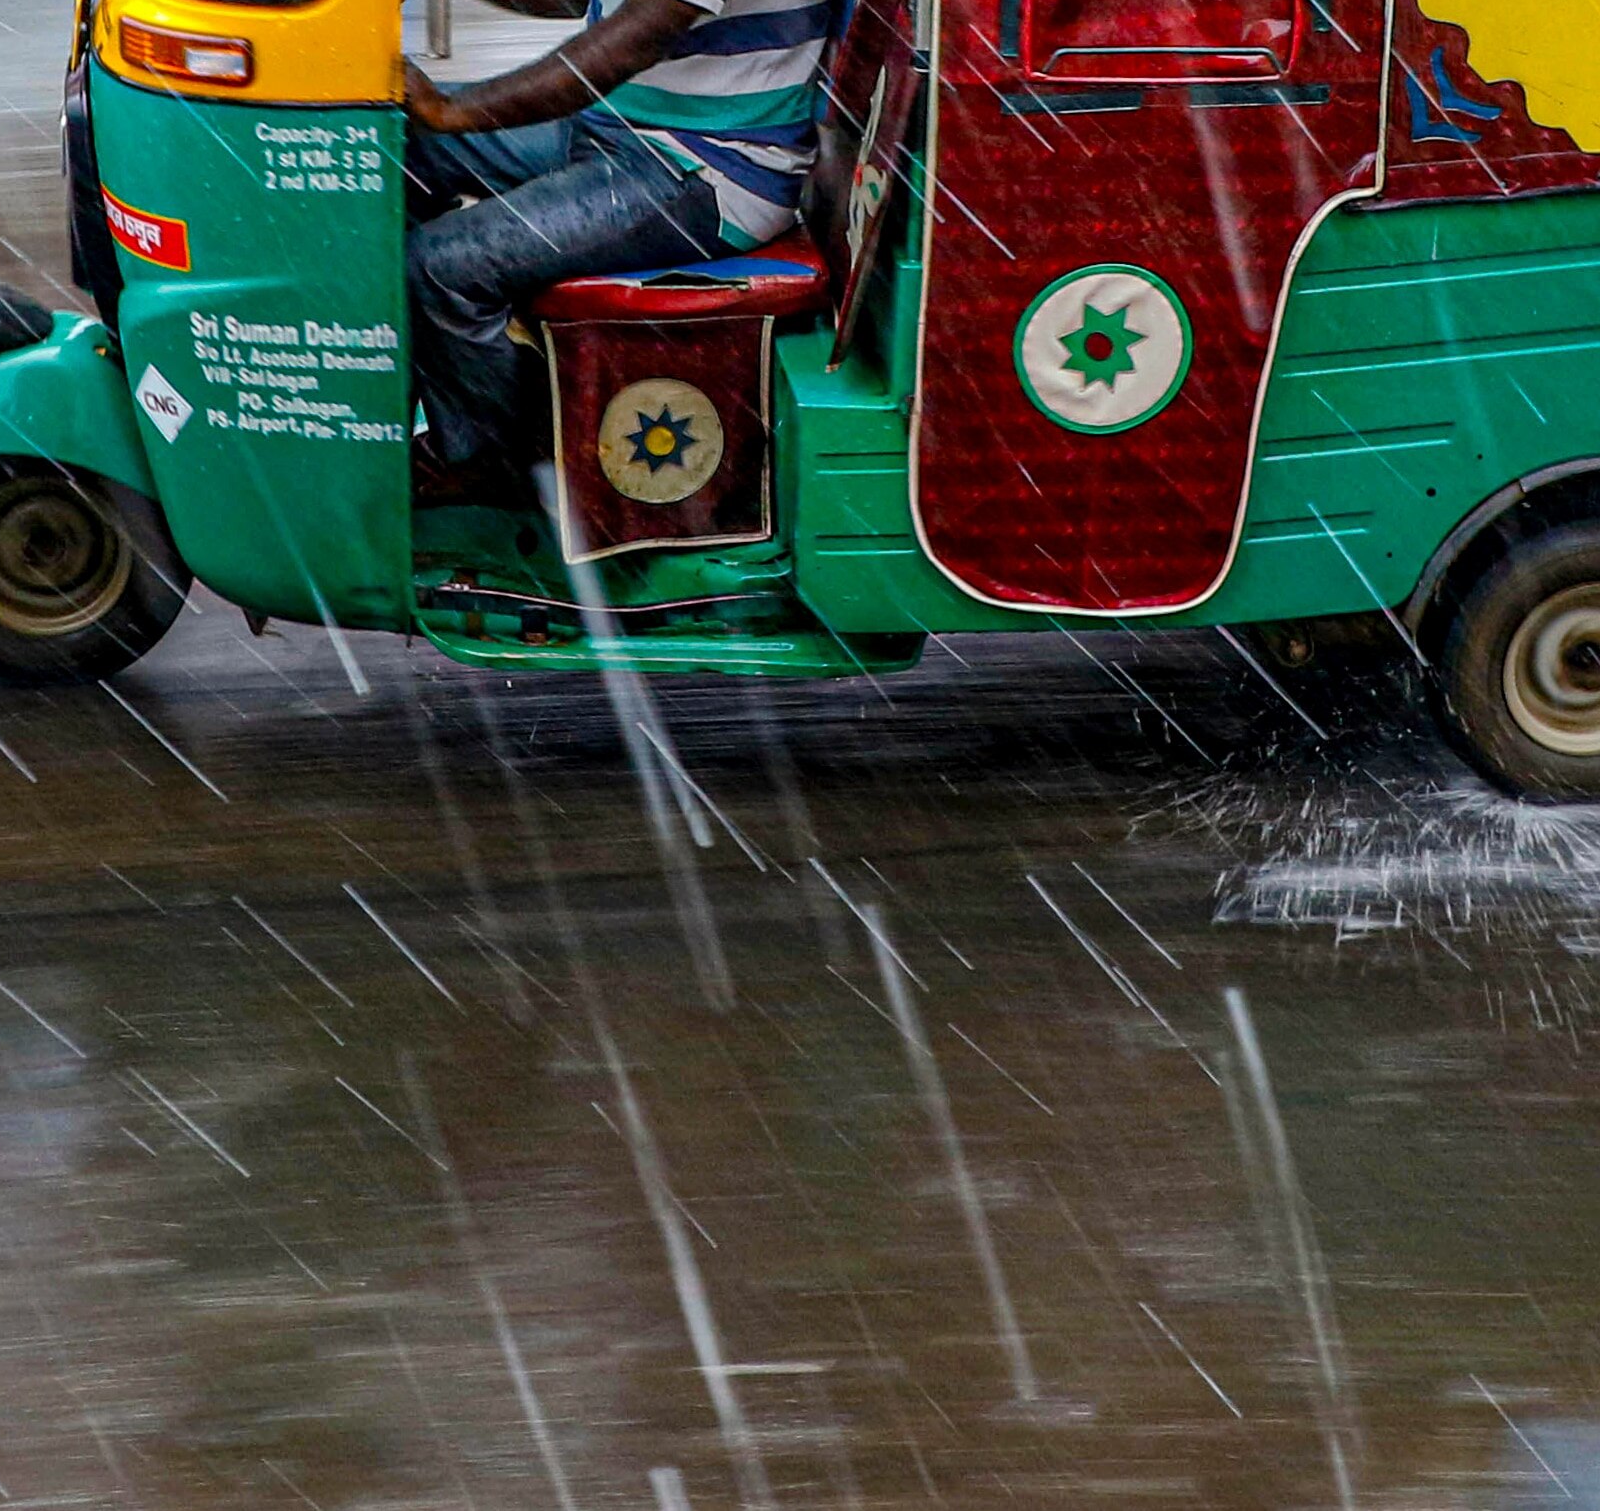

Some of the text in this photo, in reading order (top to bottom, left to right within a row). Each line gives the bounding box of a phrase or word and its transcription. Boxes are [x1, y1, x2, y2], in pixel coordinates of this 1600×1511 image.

[263, 146, 274, 167] 1
[265, 170, 277, 189] 2
[280, 172, 305, 190] nd
[190, 311, 398, 349] Sri Suman Debnath
[321, 351, 395, 372] Debnath
[144, 391, 180, 417] CNG
[340, 422, 404, 441] 799012
